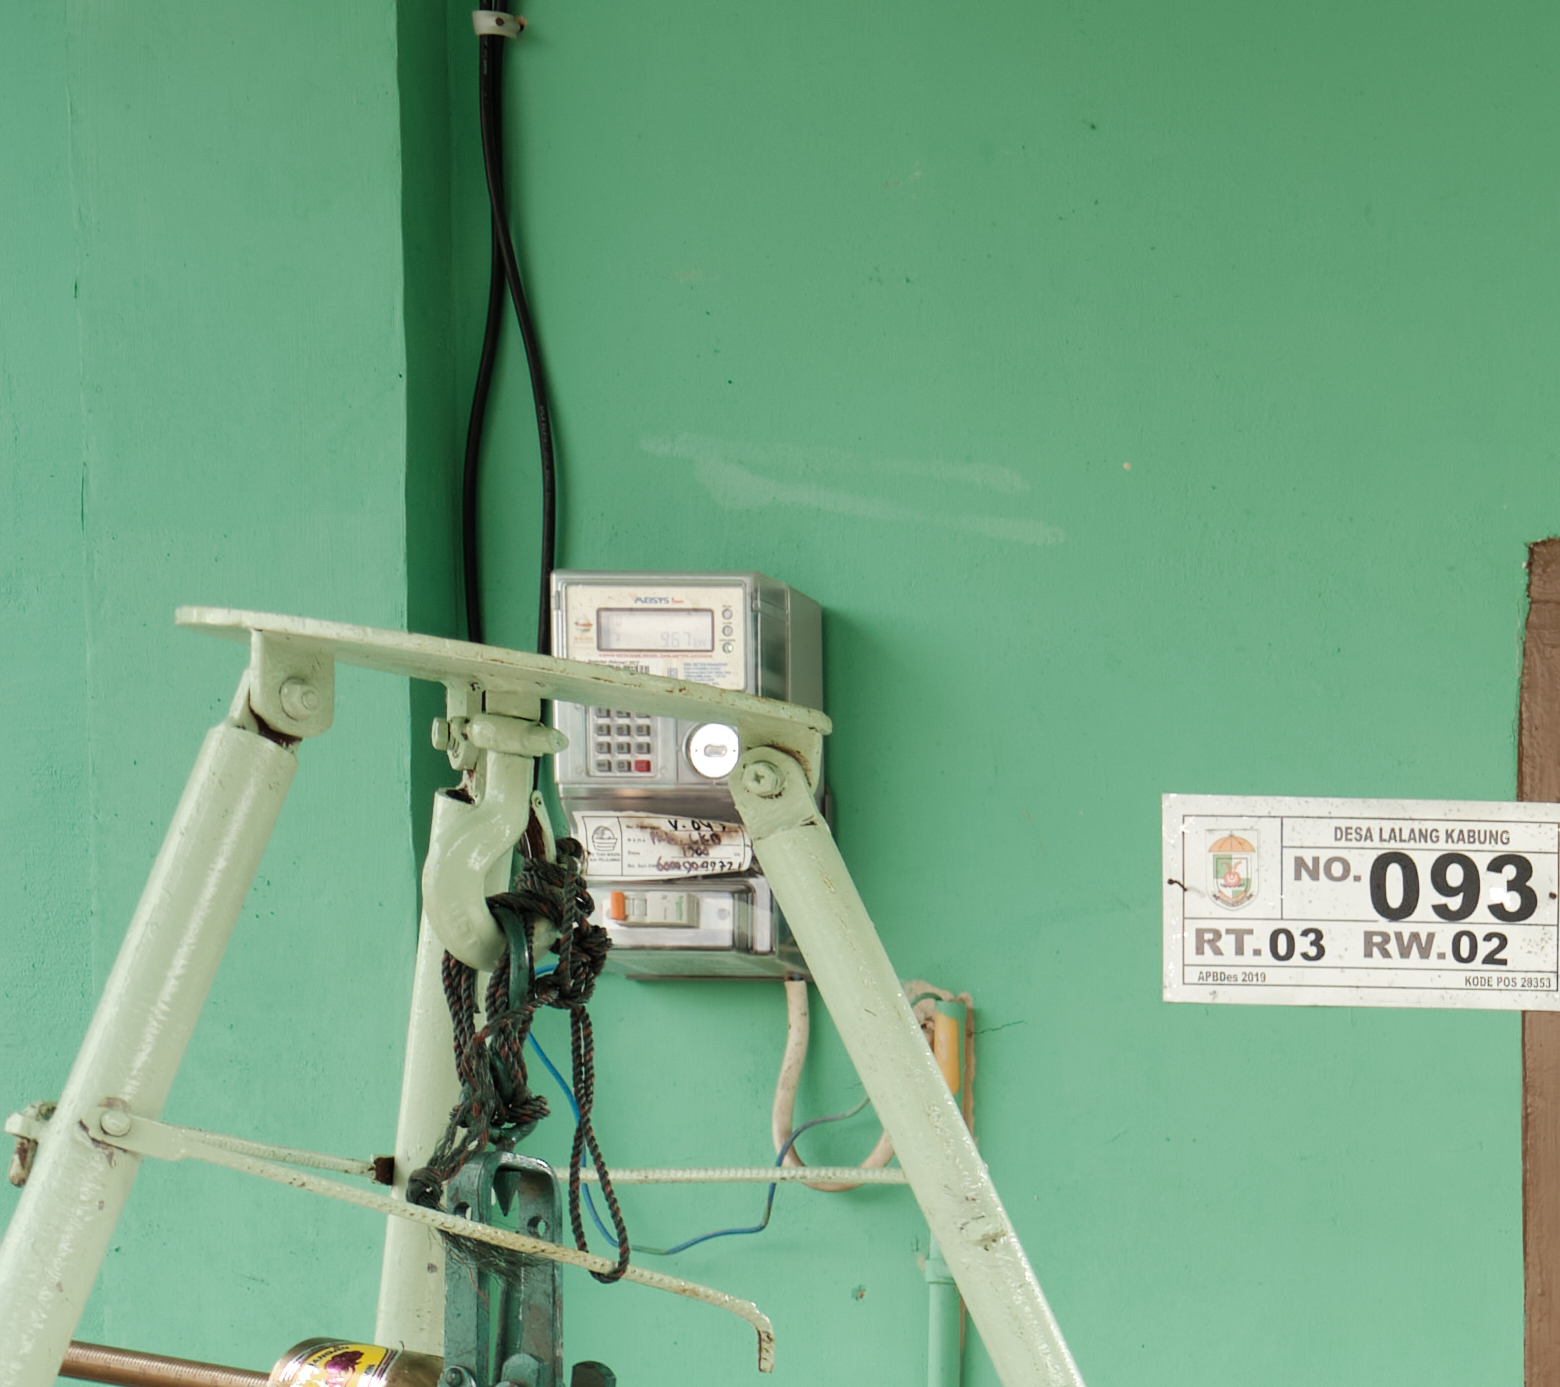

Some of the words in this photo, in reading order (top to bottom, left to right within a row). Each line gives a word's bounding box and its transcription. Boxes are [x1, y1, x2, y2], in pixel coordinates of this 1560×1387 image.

[1333, 826, 1374, 844] DESA
[1379, 827, 1440, 845] LALANG
[1444, 828, 1511, 846] KABUNG
[1293, 855, 1362, 883] NO.
[1368, 851, 1539, 923] 093
[1197, 970, 1239, 983] APBDes
[1464, 974, 1494, 988] KODE
[1495, 976, 1518, 989] POS
[1520, 977, 1552, 990] 28353
